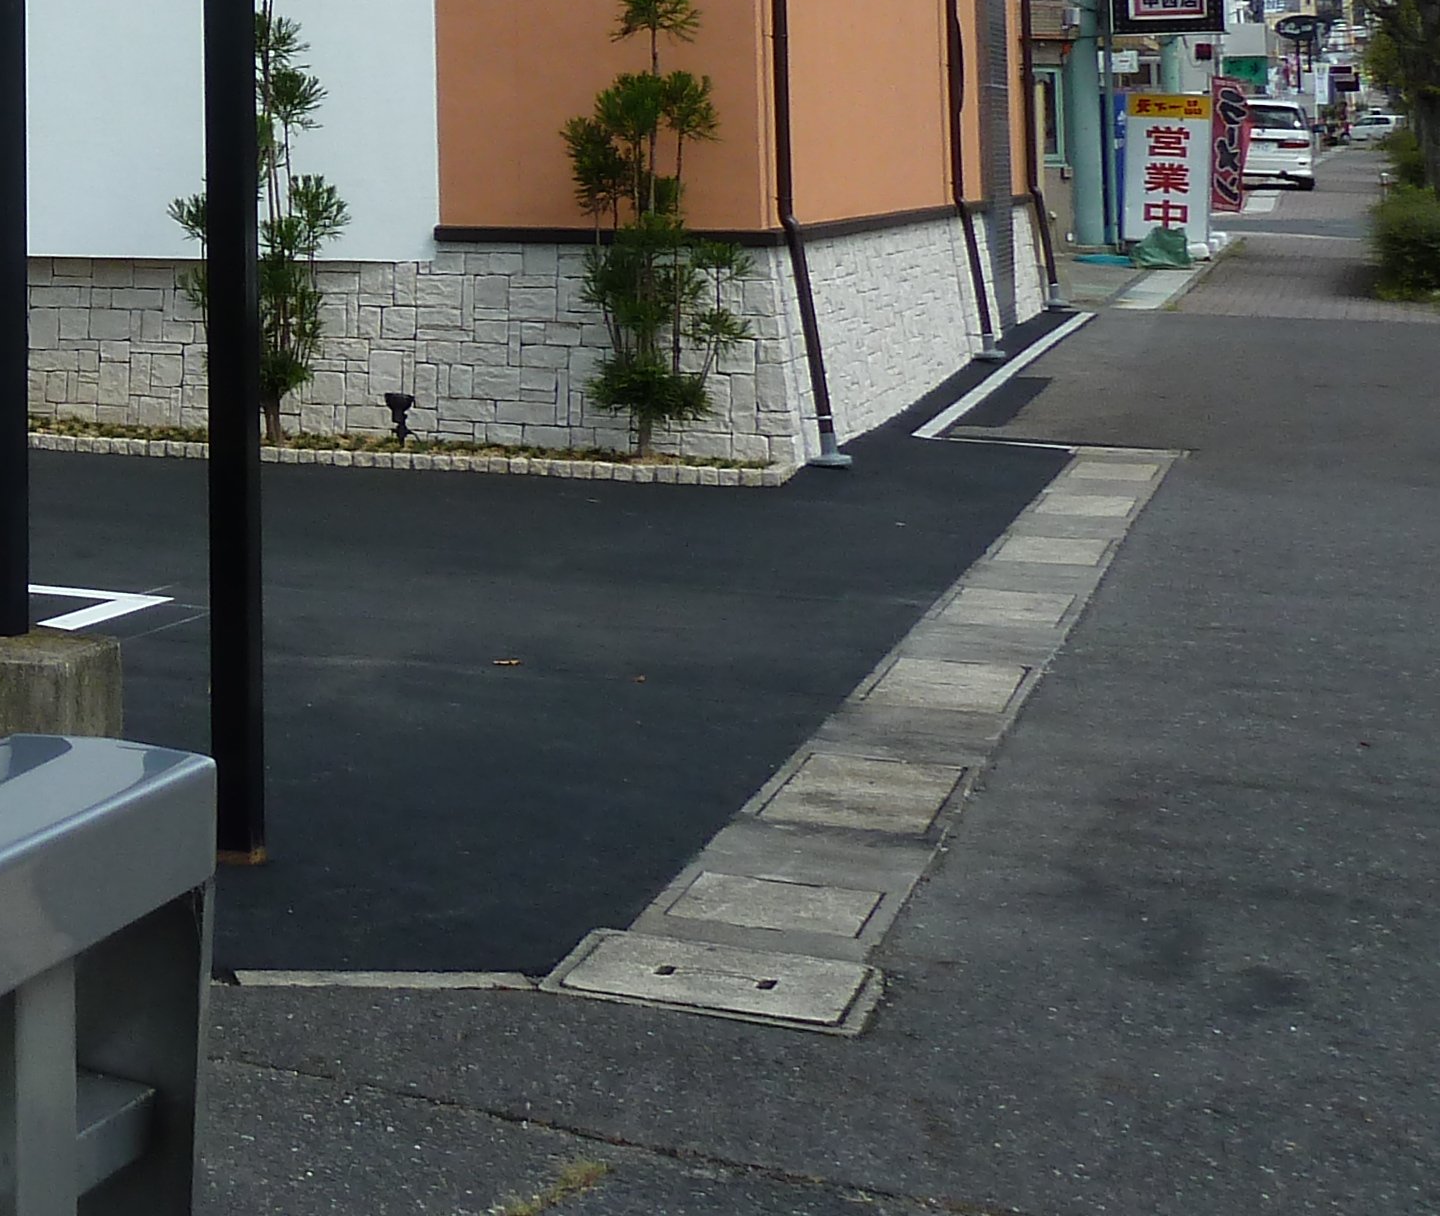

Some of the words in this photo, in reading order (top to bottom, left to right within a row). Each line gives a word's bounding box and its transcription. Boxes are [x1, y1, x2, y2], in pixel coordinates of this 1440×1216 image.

[1136, 98, 1202, 115] 天下一品
[1216, 86, 1249, 204] ラーメン
[1144, 125, 1190, 229] 営業中
